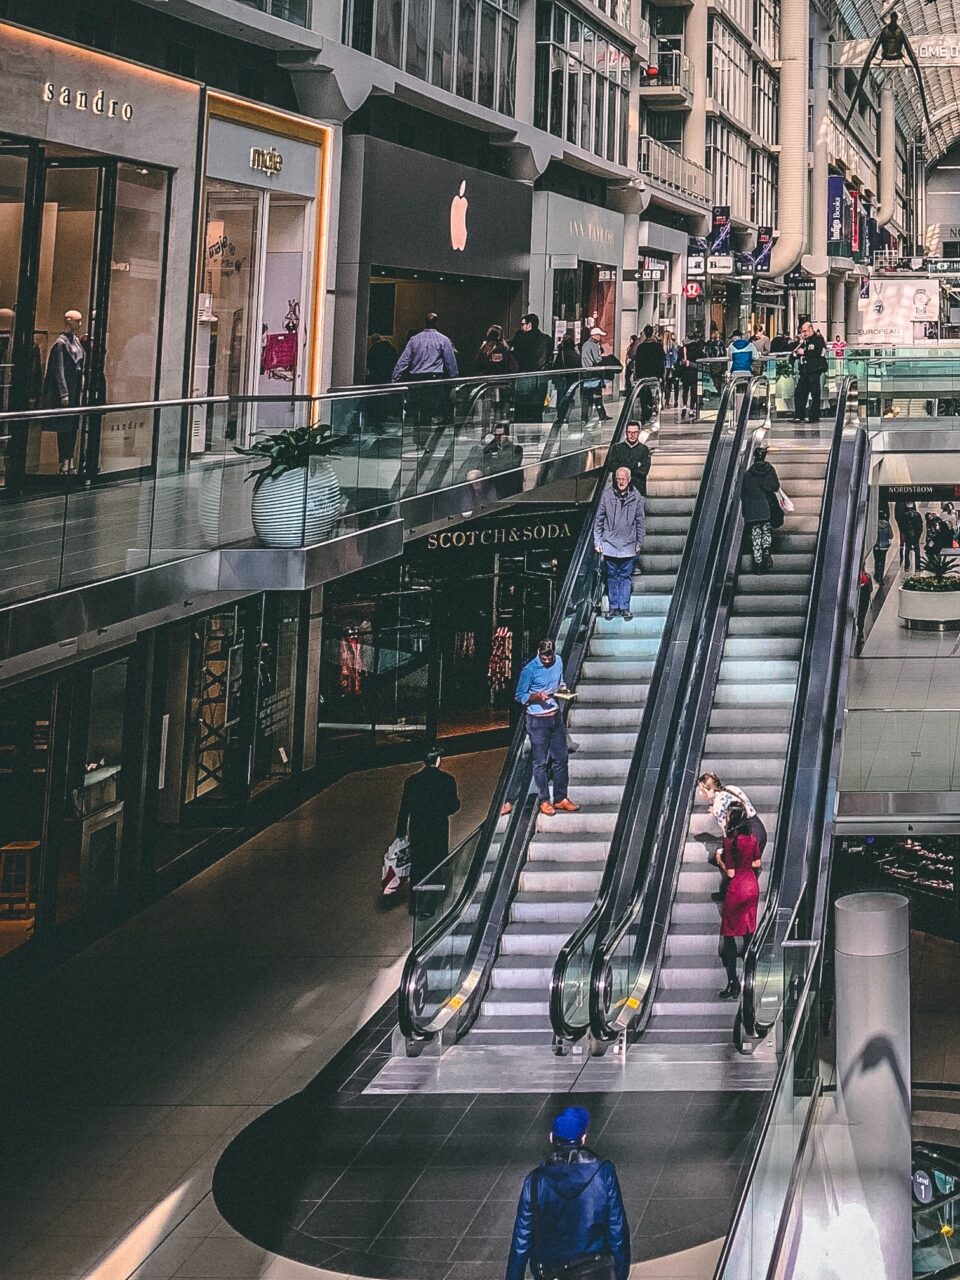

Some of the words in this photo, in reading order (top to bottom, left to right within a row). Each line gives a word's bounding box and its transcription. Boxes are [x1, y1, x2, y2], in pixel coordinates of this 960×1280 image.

[43, 81, 134, 121] sandro
[249, 146, 284, 176] maje
[832, 197, 841, 218] Books
[831, 219, 840, 241] Indigo
[888, 485, 933, 494] NORDSTROM
